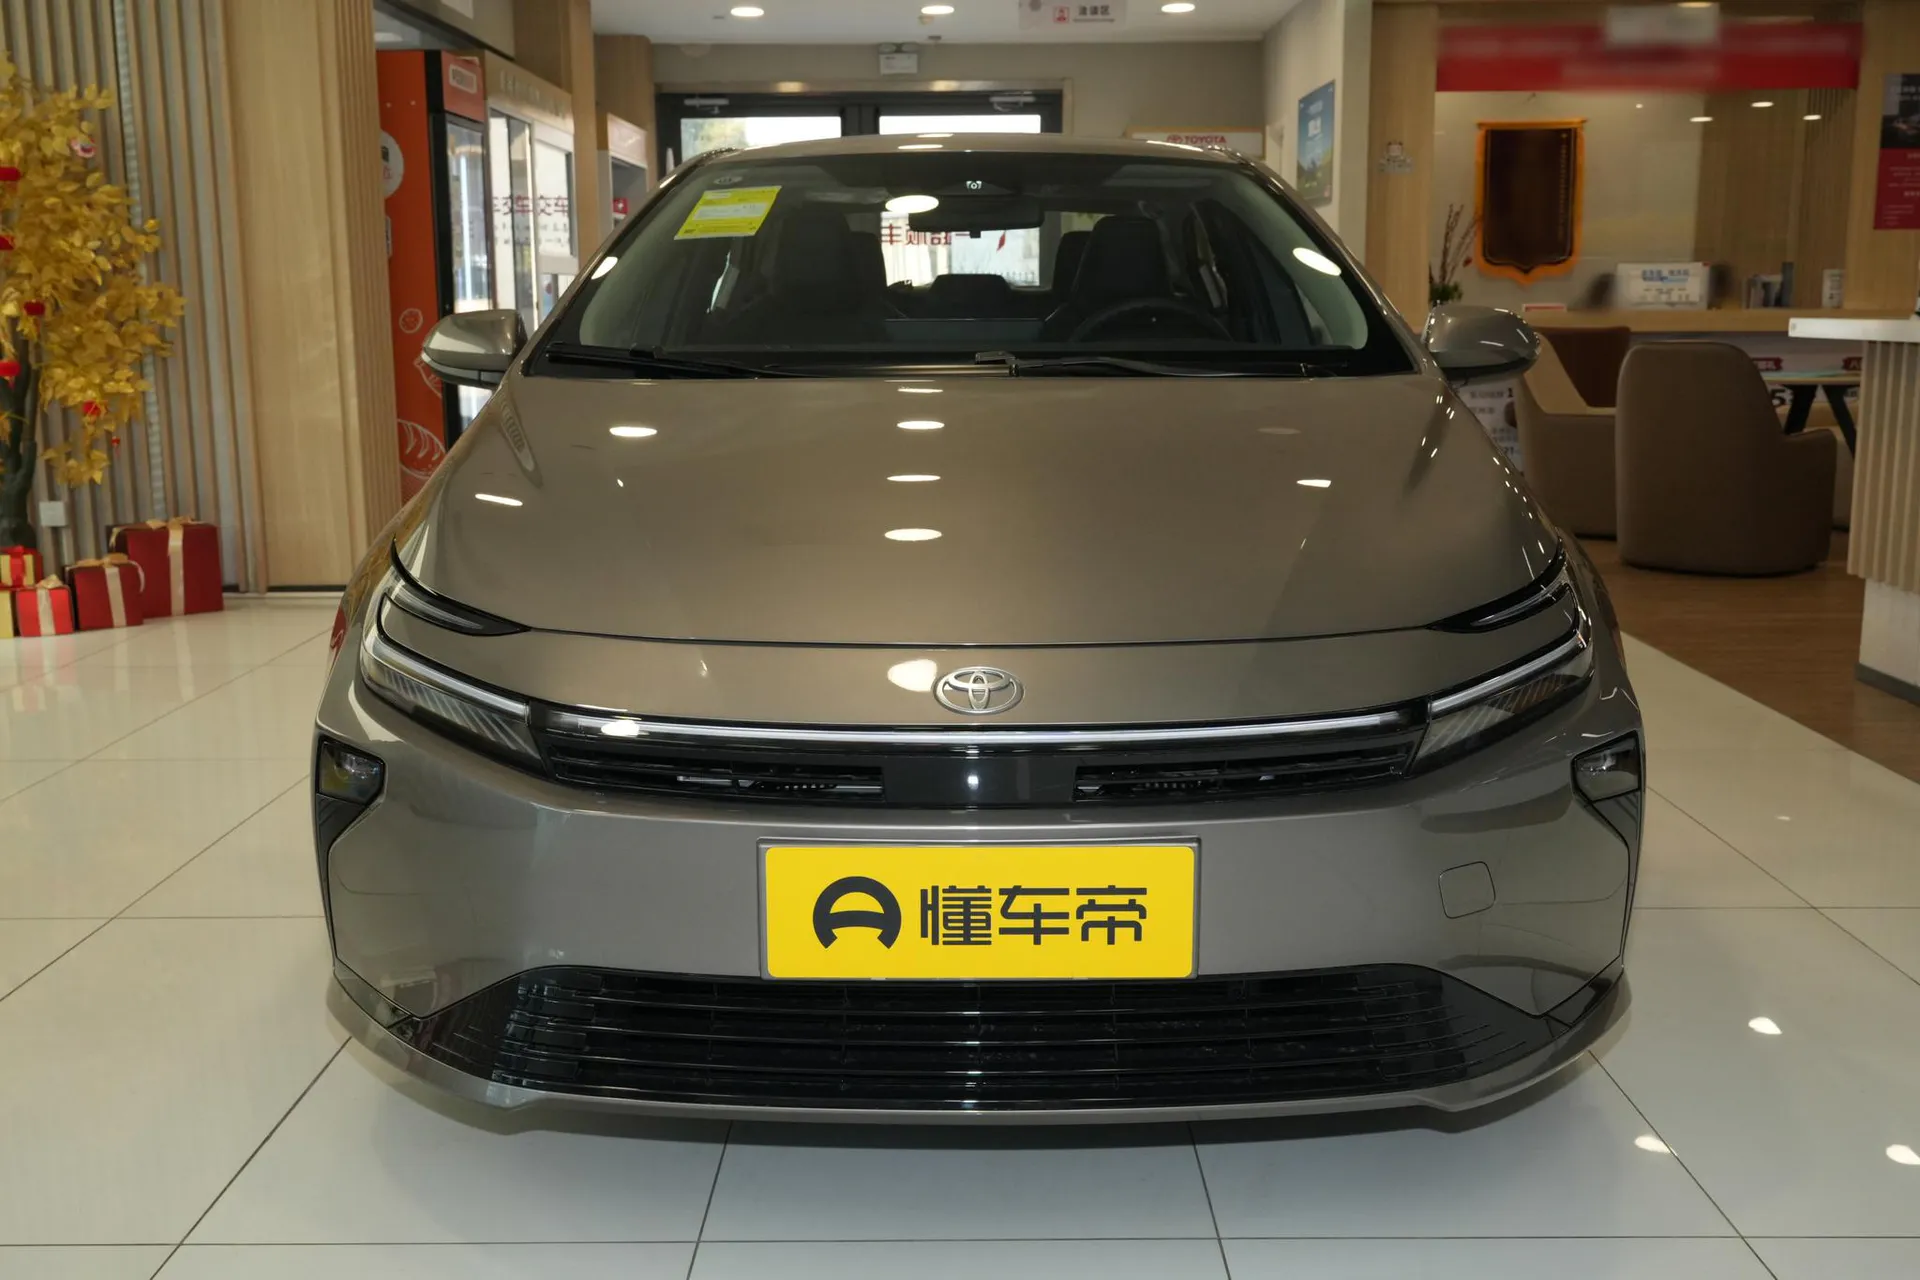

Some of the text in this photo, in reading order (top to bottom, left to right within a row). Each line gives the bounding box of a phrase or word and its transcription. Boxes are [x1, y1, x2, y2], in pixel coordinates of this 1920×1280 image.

[1184, 135, 1227, 145] TOYOTA
[920, 885, 1147, 945] 懂车帝
